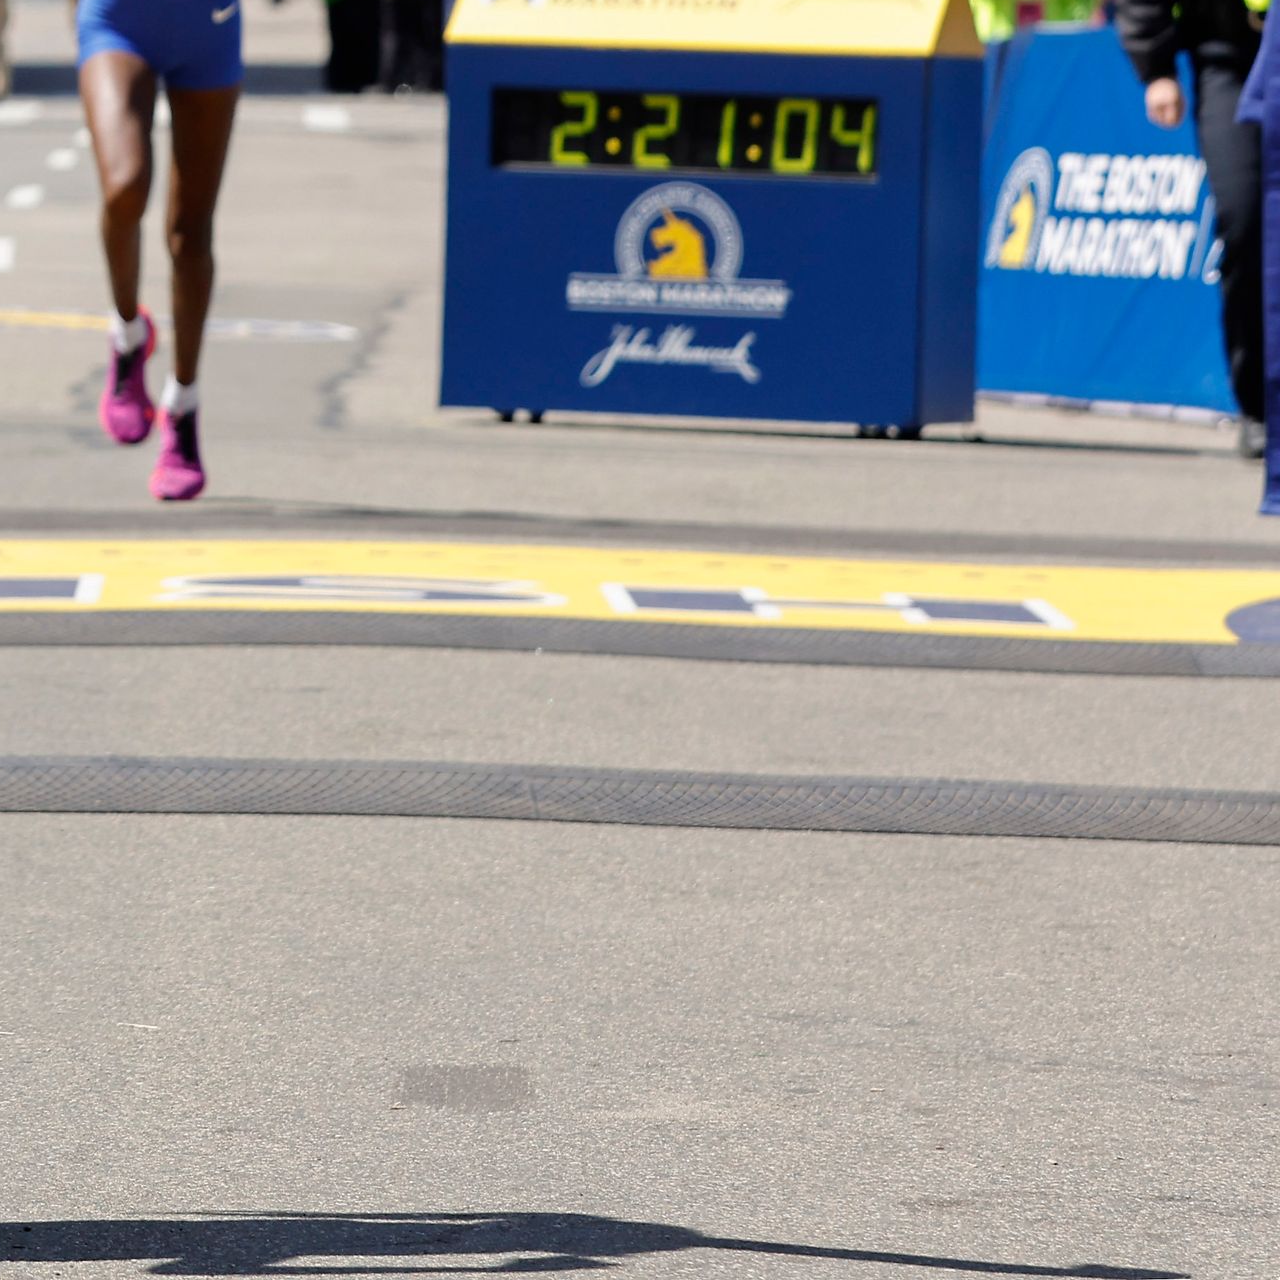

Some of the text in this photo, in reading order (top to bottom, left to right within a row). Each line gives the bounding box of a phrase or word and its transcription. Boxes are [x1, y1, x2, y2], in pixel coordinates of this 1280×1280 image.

[550, 90, 877, 175] 2:21:04
[1053, 151, 1208, 216] THE BOSTON
[1034, 215, 1198, 280] MARATHON
[566, 280, 658, 307] BOSTON
